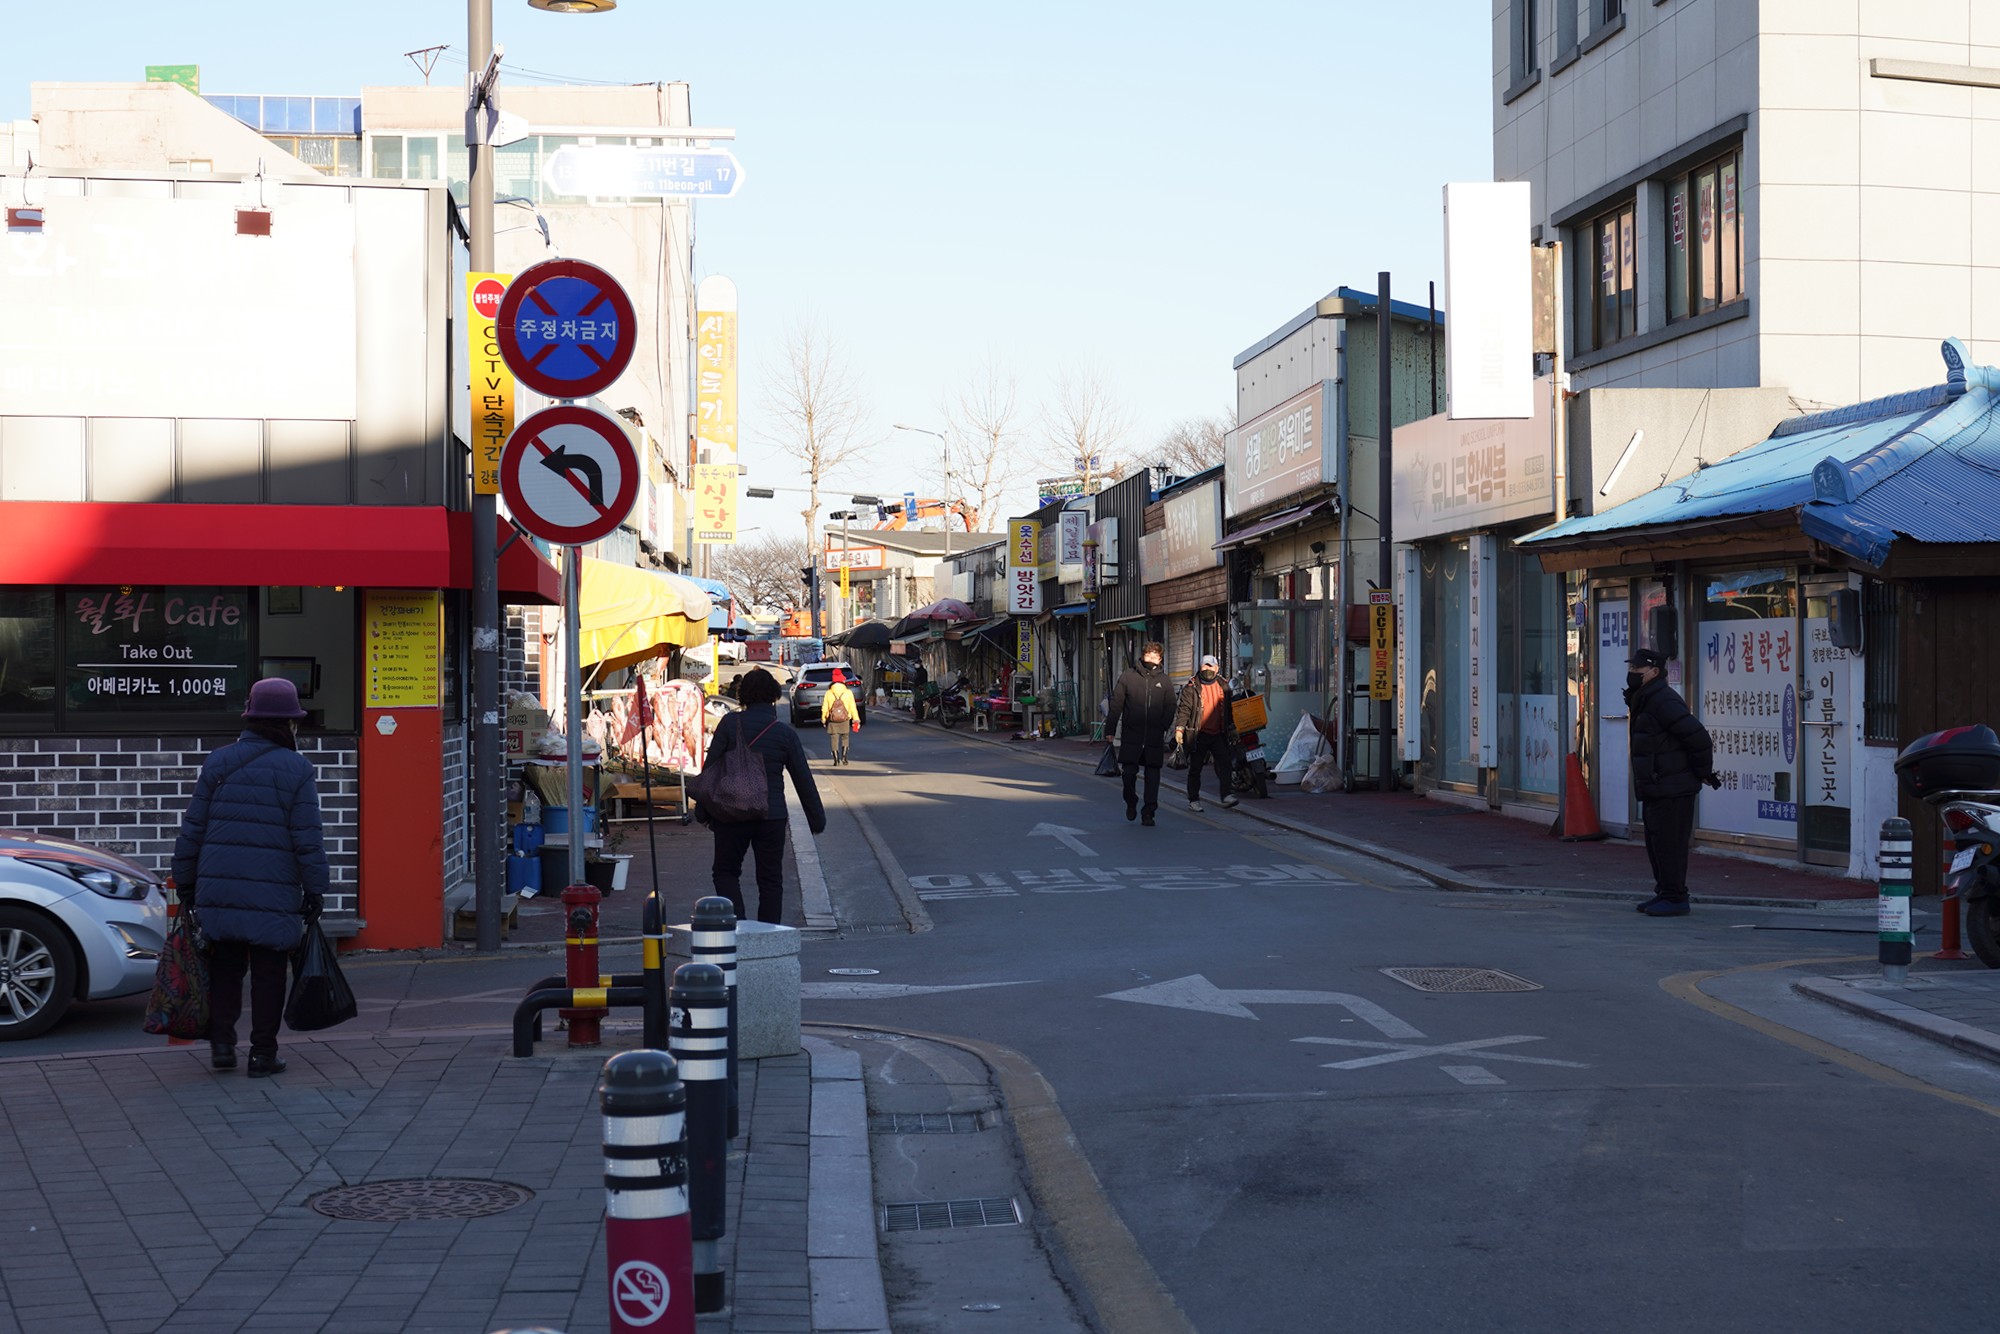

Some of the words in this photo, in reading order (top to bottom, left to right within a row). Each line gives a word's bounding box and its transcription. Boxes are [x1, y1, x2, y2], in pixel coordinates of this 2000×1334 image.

[658, 179, 713, 194] 11beon-gil
[716, 168, 731, 182] 17
[474, 292, 503, 305] 불법주정
[519, 318, 617, 341] 주정차금지
[1431, 442, 1507, 514] 유니크학생복
[703, 482, 730, 531] 식당
[1019, 525, 1033, 564] 옷수선
[1016, 570, 1035, 610] 방앗간
[164, 595, 241, 628] Cafe
[119, 644, 158, 660] Take
[162, 644, 194, 660] Out
[1019, 620, 1032, 664] 만물상회
[1375, 606, 1389, 690] CCTV단속구간
[1707, 629, 1792, 675] 대성철학관
[1811, 628, 1831, 643] (국보
[87, 677, 161, 696] 아메리카노
[168, 677, 227, 698] 1,000원
[906, 862, 1362, 902] 일방통행
